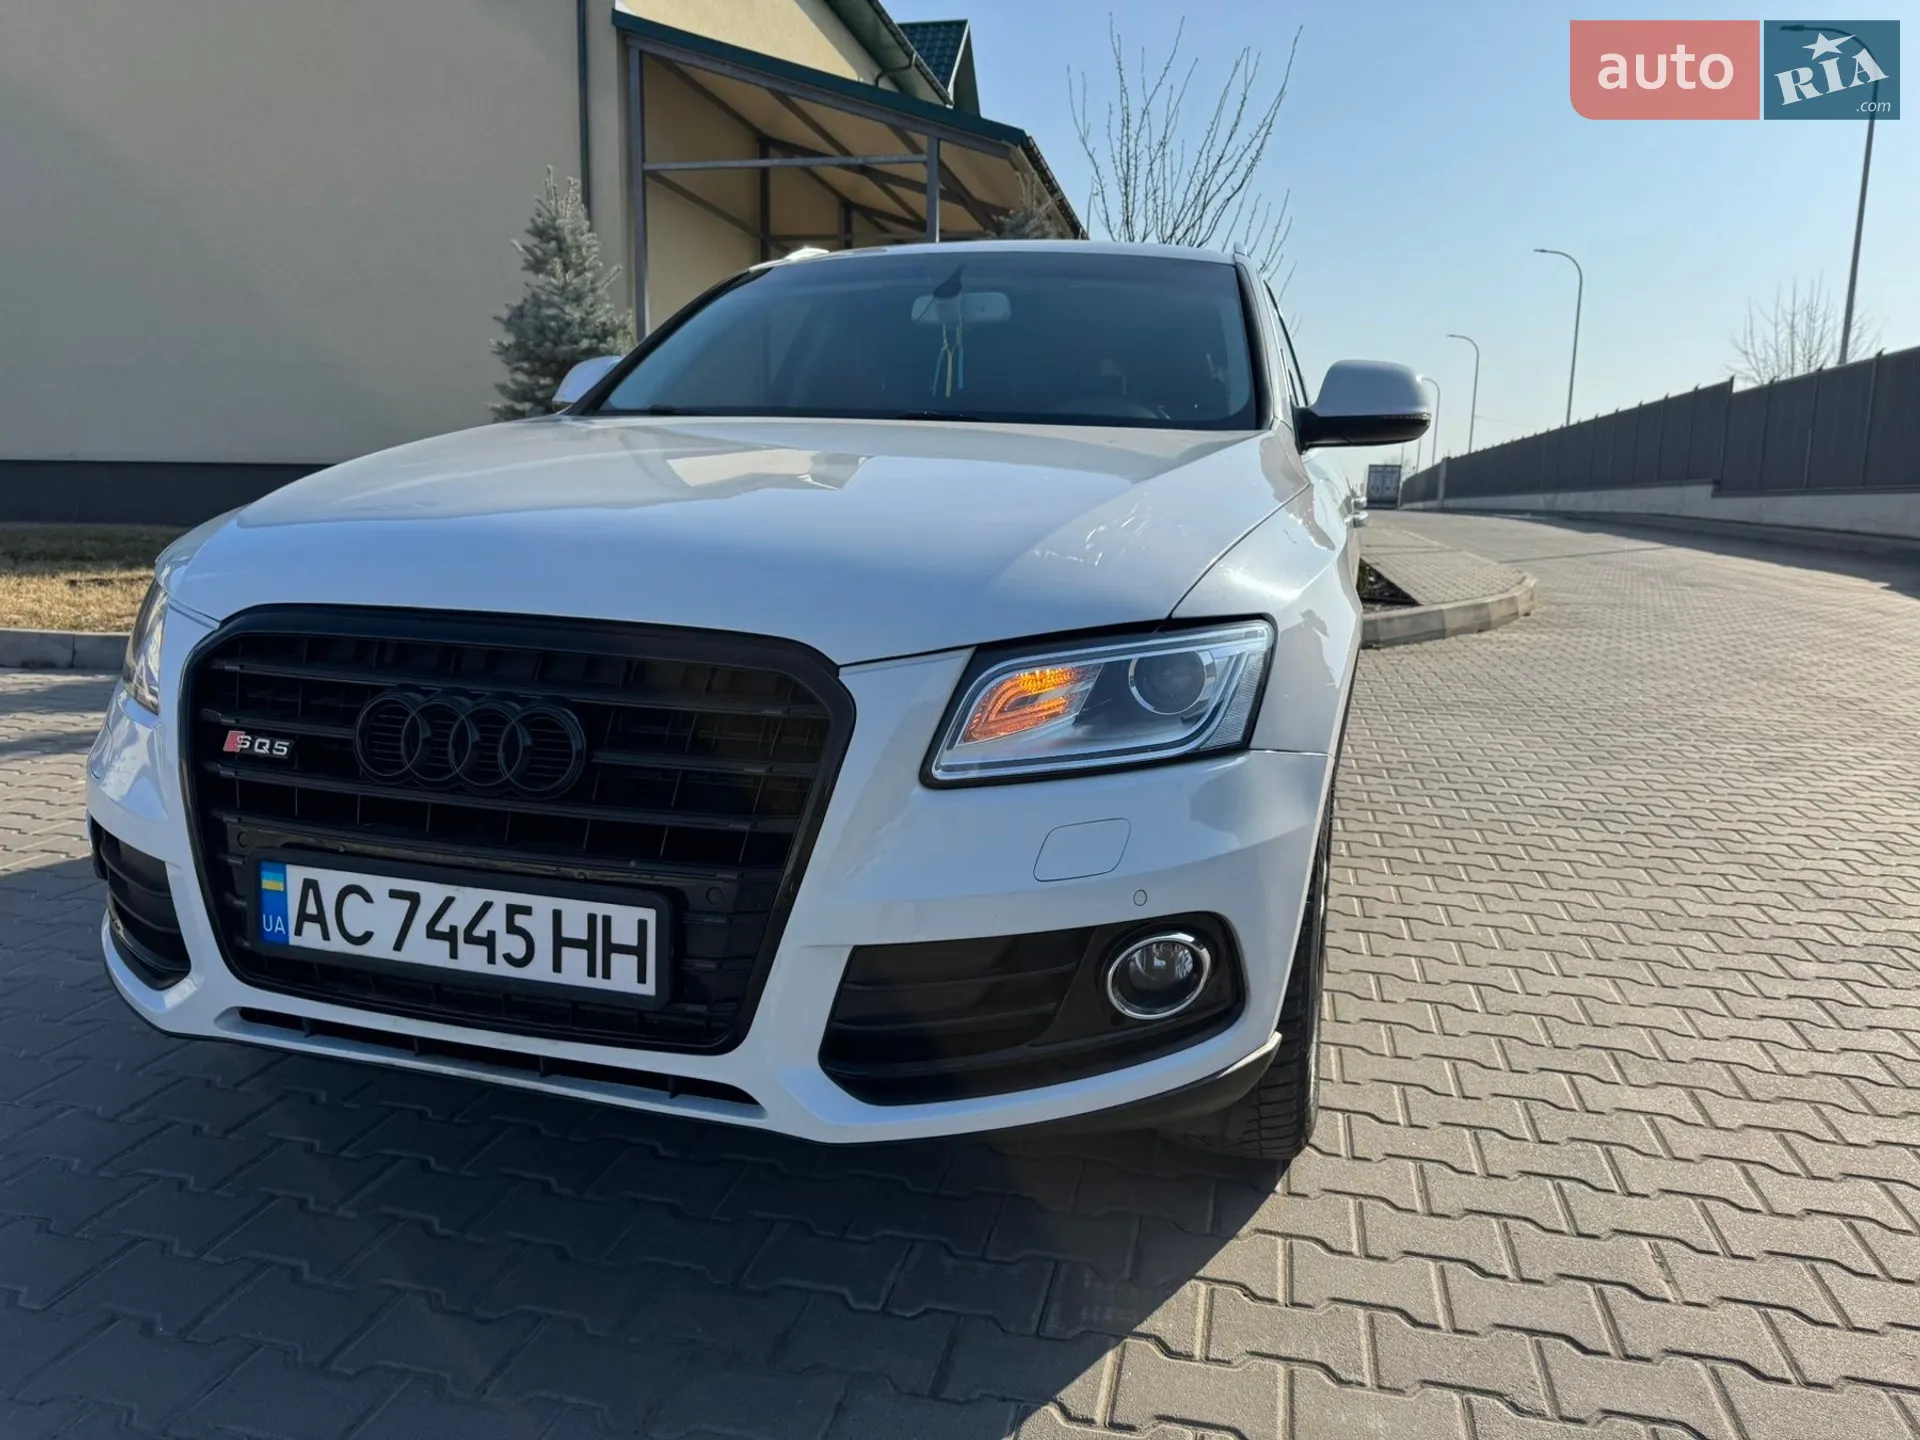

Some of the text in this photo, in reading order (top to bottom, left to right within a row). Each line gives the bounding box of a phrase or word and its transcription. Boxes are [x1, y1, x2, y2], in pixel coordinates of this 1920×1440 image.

[236, 735, 290, 756] SQ5
[262, 914, 286, 935] UA
[294, 878, 648, 985] AC 7445 HH
